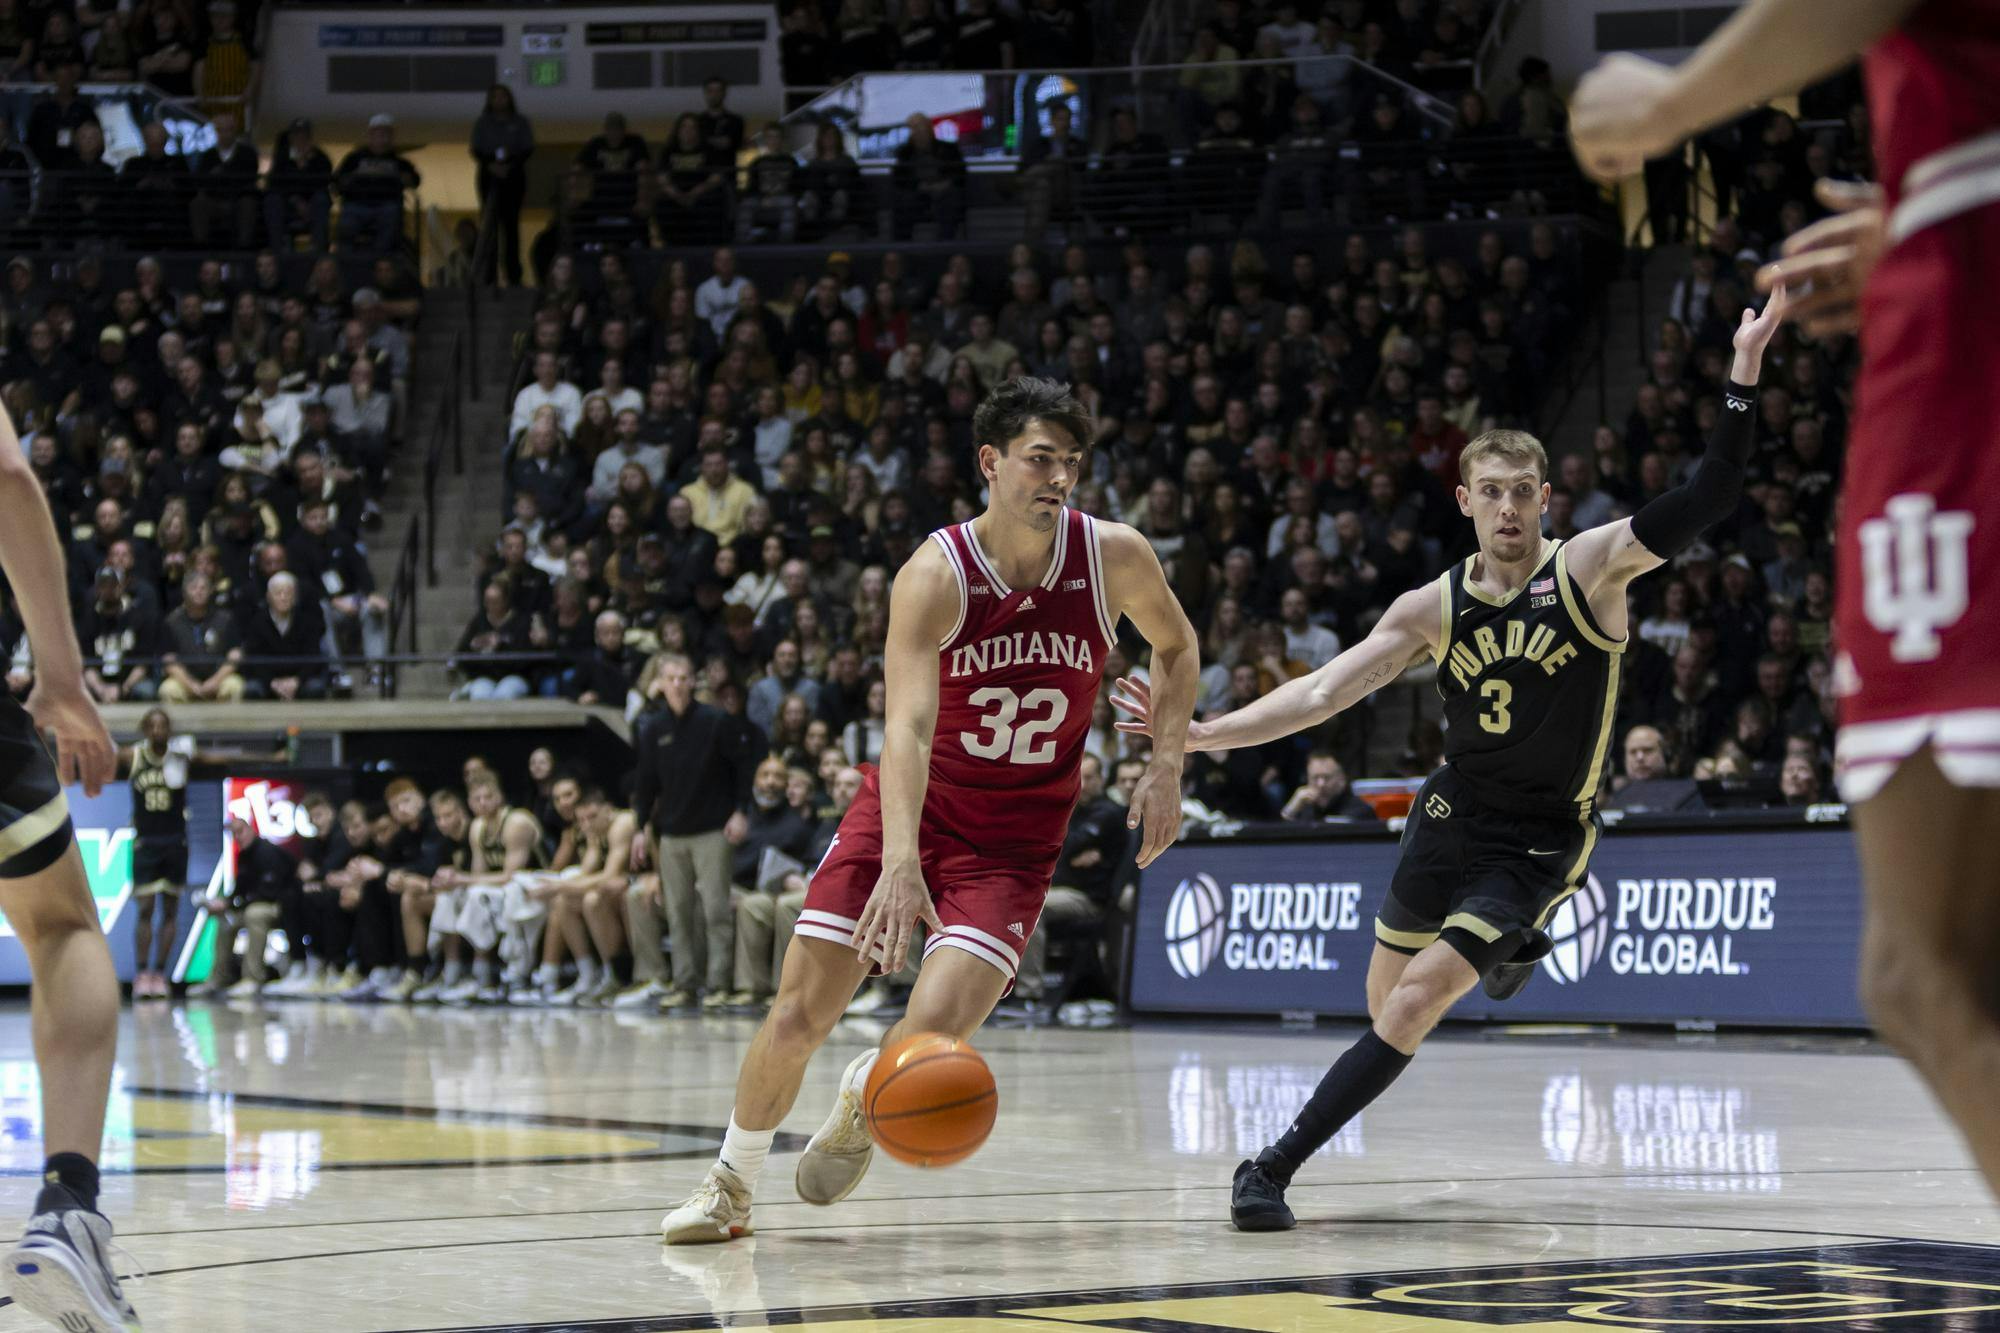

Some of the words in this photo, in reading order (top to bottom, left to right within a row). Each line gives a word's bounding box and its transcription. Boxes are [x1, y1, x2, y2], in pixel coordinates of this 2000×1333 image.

[950, 631, 1093, 677] INDIANA
[1449, 620, 1578, 692] PURDUE
[960, 687, 1069, 765] 32
[1479, 679, 1513, 735] 3
[1228, 882, 1362, 931] PURDUE
[1614, 877, 1777, 931] PURDUE
[1609, 933, 1741, 976] GLOBAL
